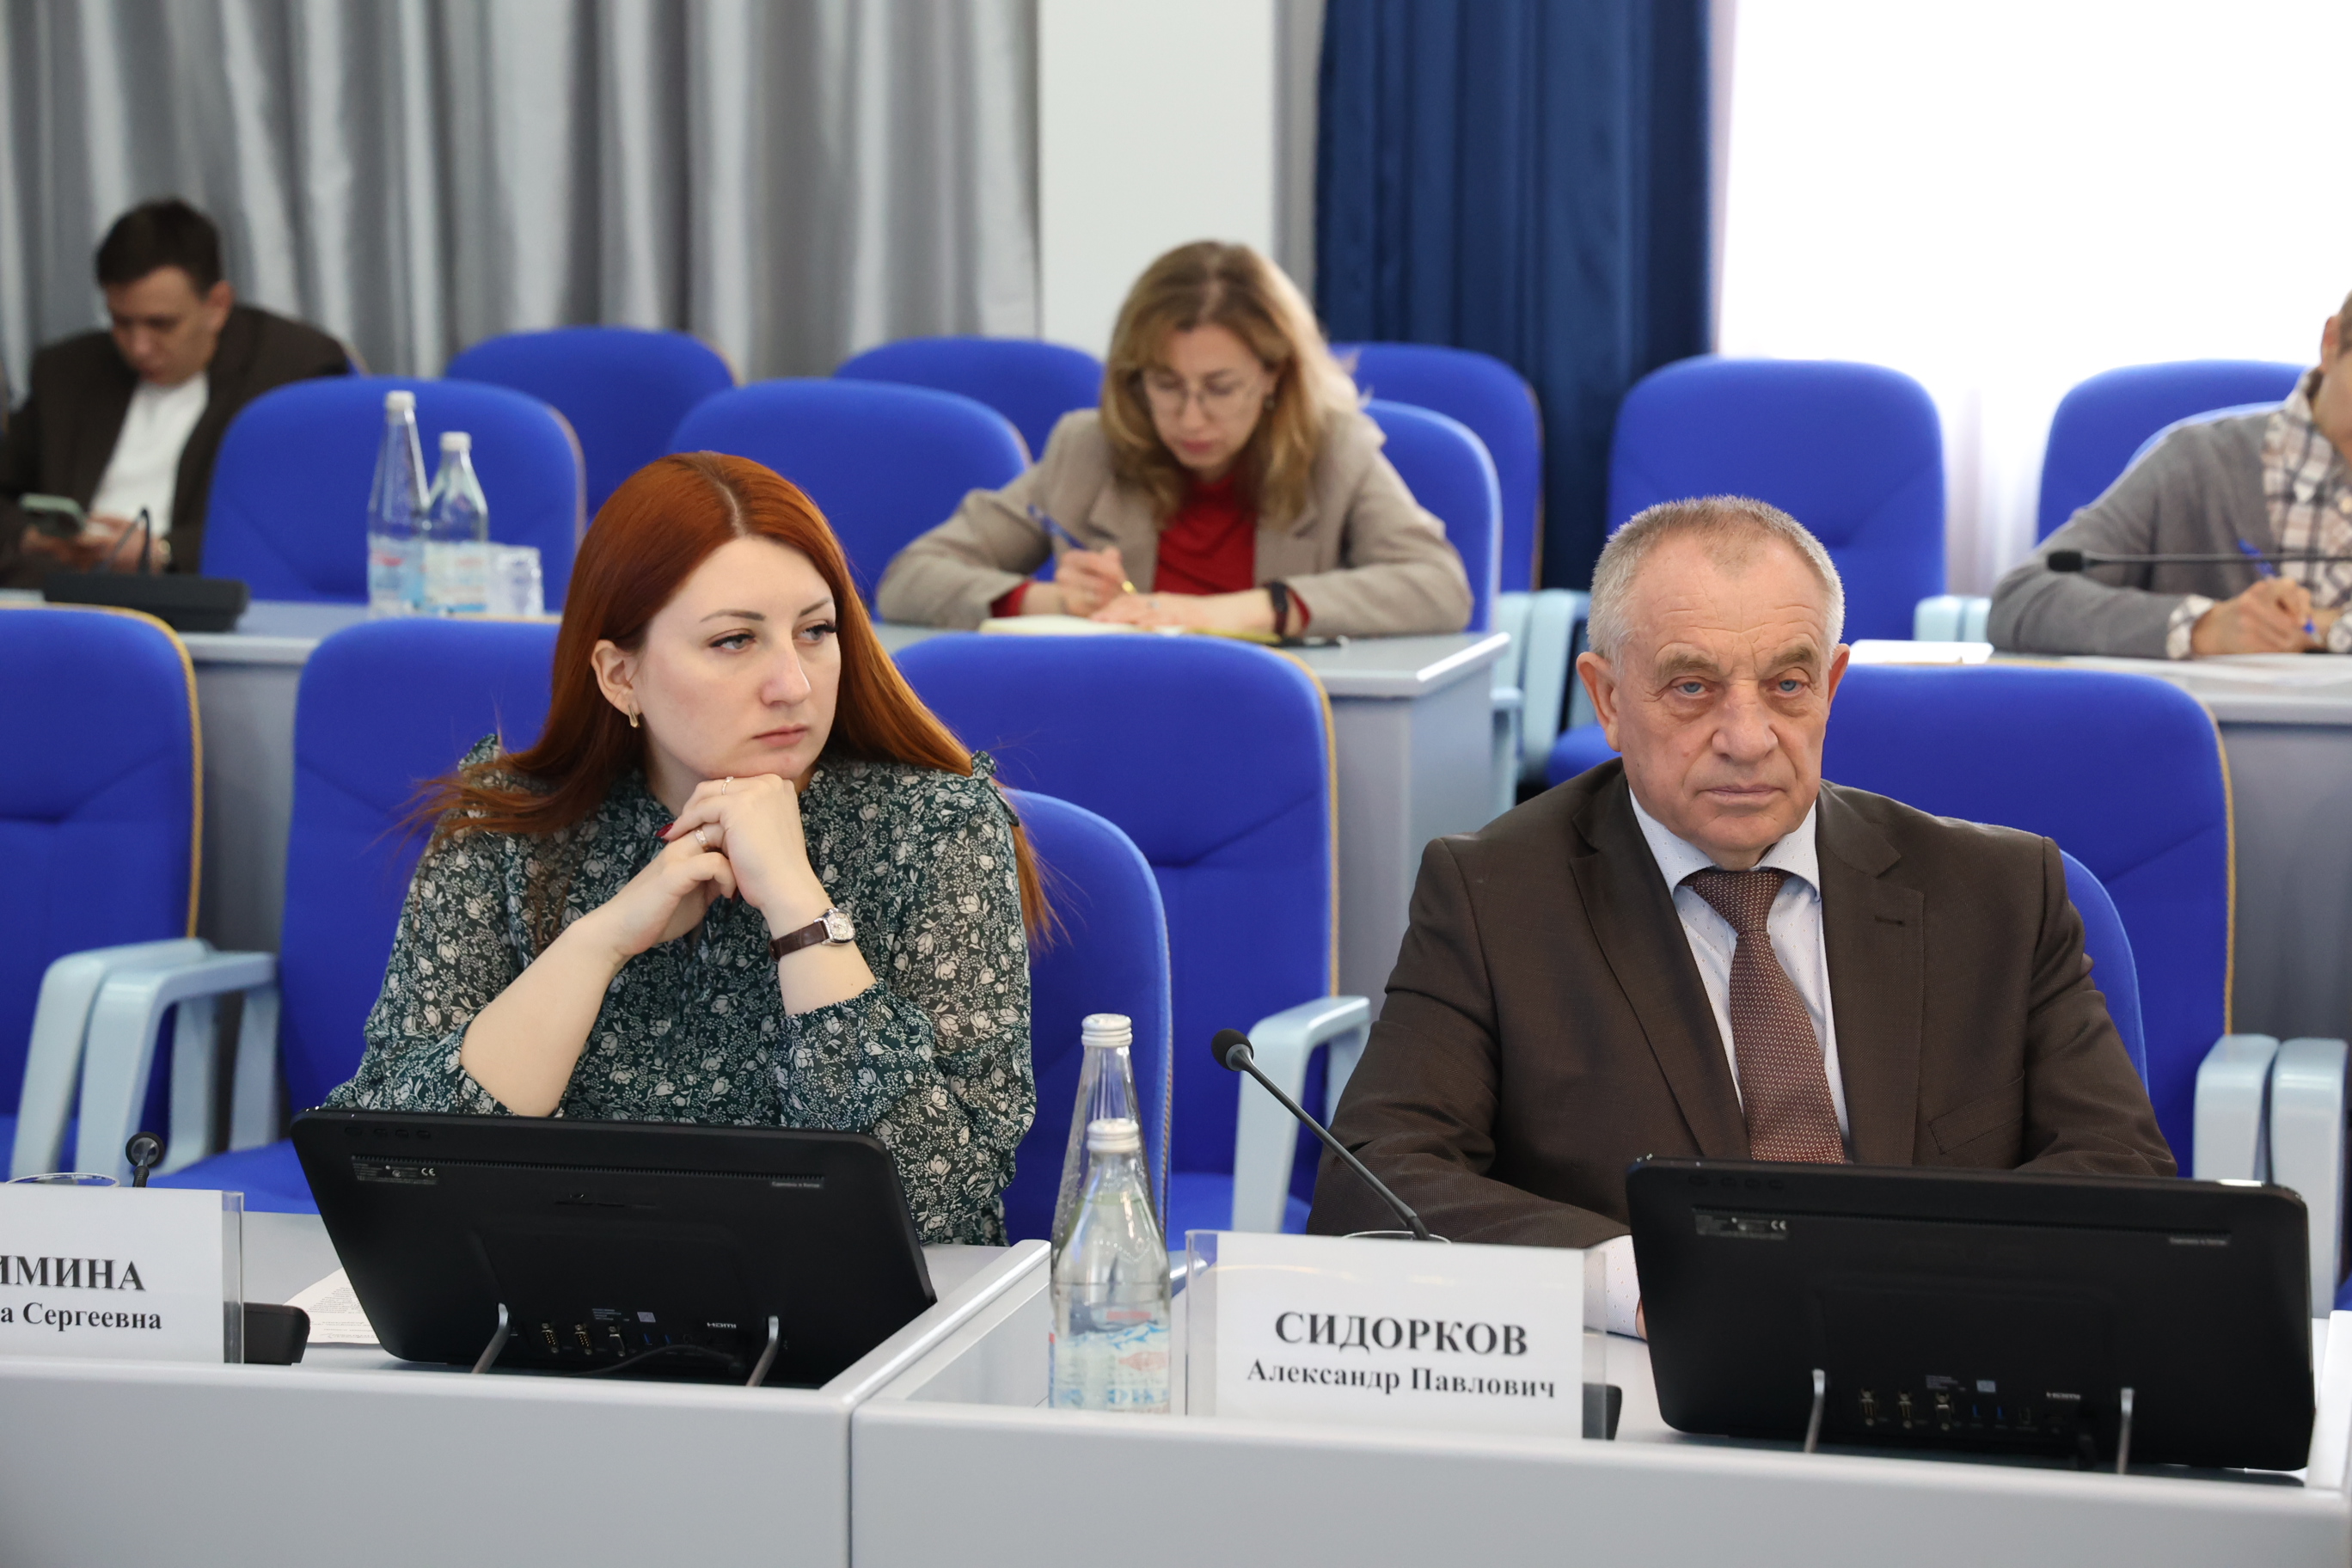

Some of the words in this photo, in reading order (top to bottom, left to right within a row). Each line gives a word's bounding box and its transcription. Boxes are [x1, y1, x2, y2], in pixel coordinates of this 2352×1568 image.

[22, 1301, 162, 1332] Сергеевна
[1274, 1310, 1529, 1357] СИДОРКОВ
[1247, 1358, 1401, 1395] Александр
[1411, 1367, 1557, 1399] Павлович
